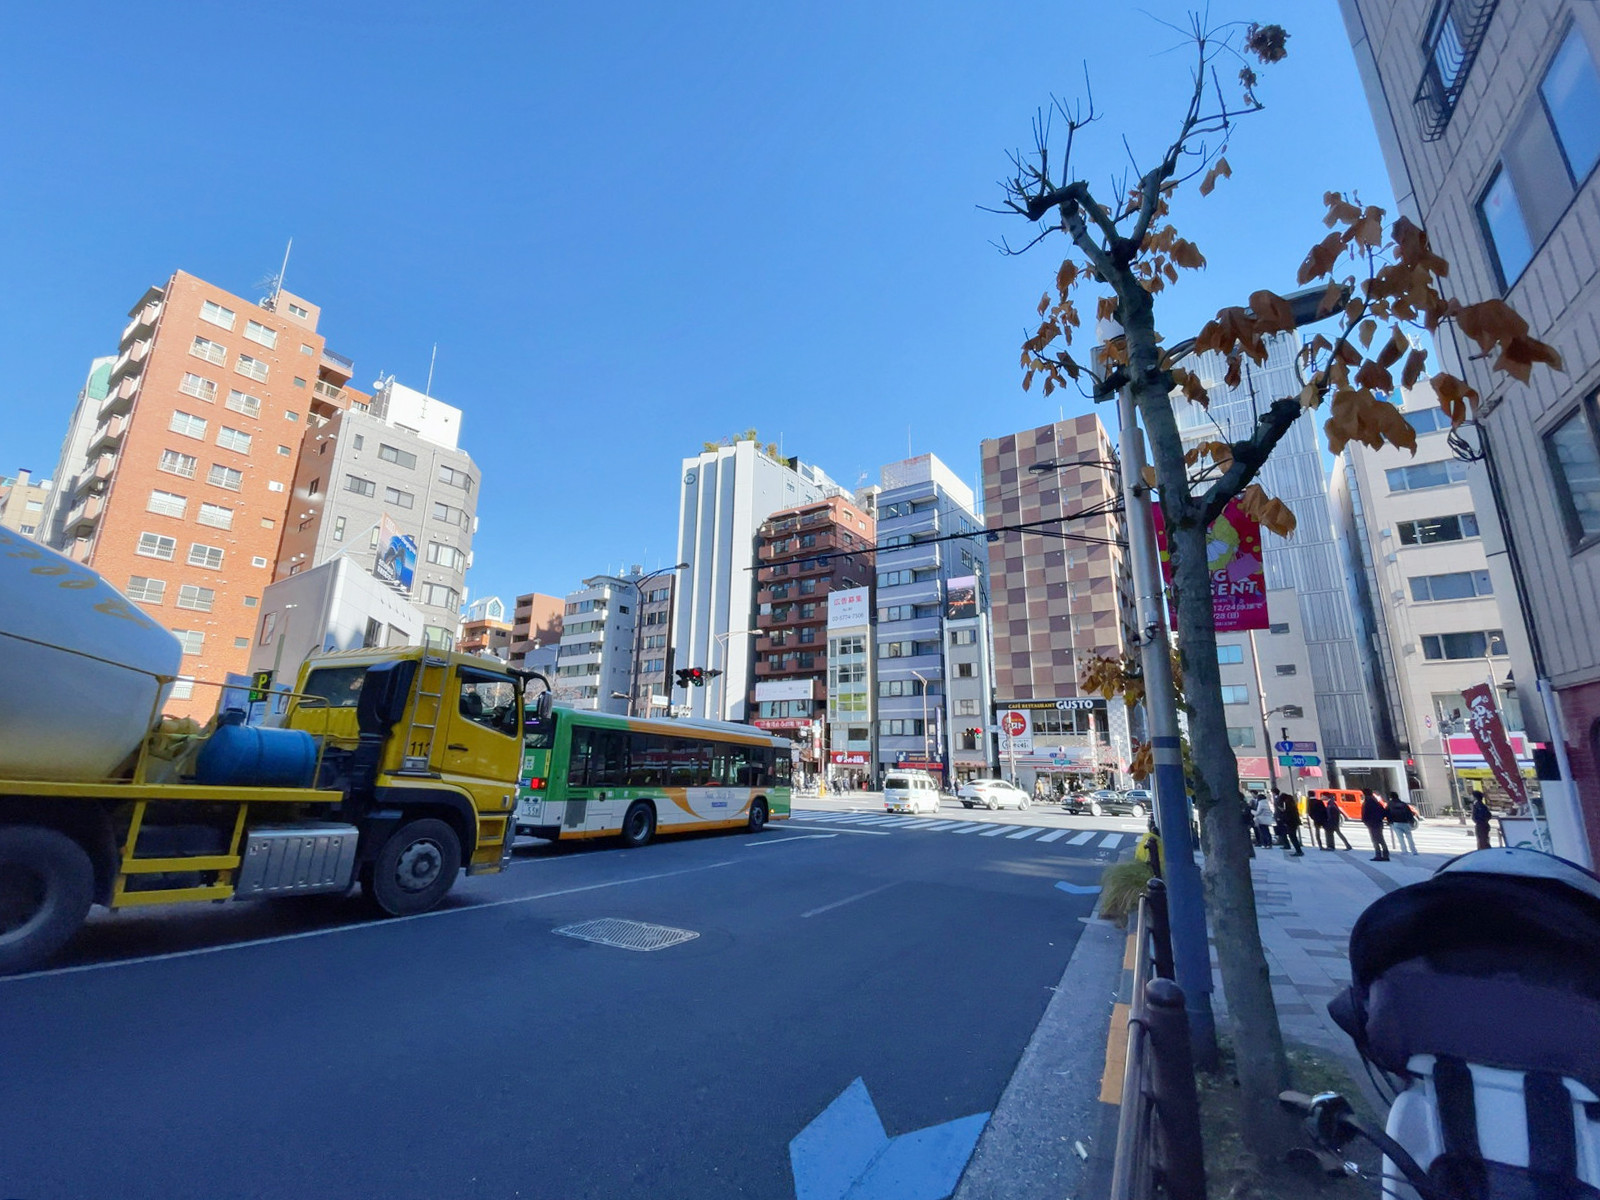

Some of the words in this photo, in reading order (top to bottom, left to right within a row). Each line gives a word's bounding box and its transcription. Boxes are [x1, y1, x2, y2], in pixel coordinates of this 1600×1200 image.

[258, 673, 268, 690] P
[1056, 700, 1094, 709] GUSTO
[1292, 757, 1305, 766] 301
